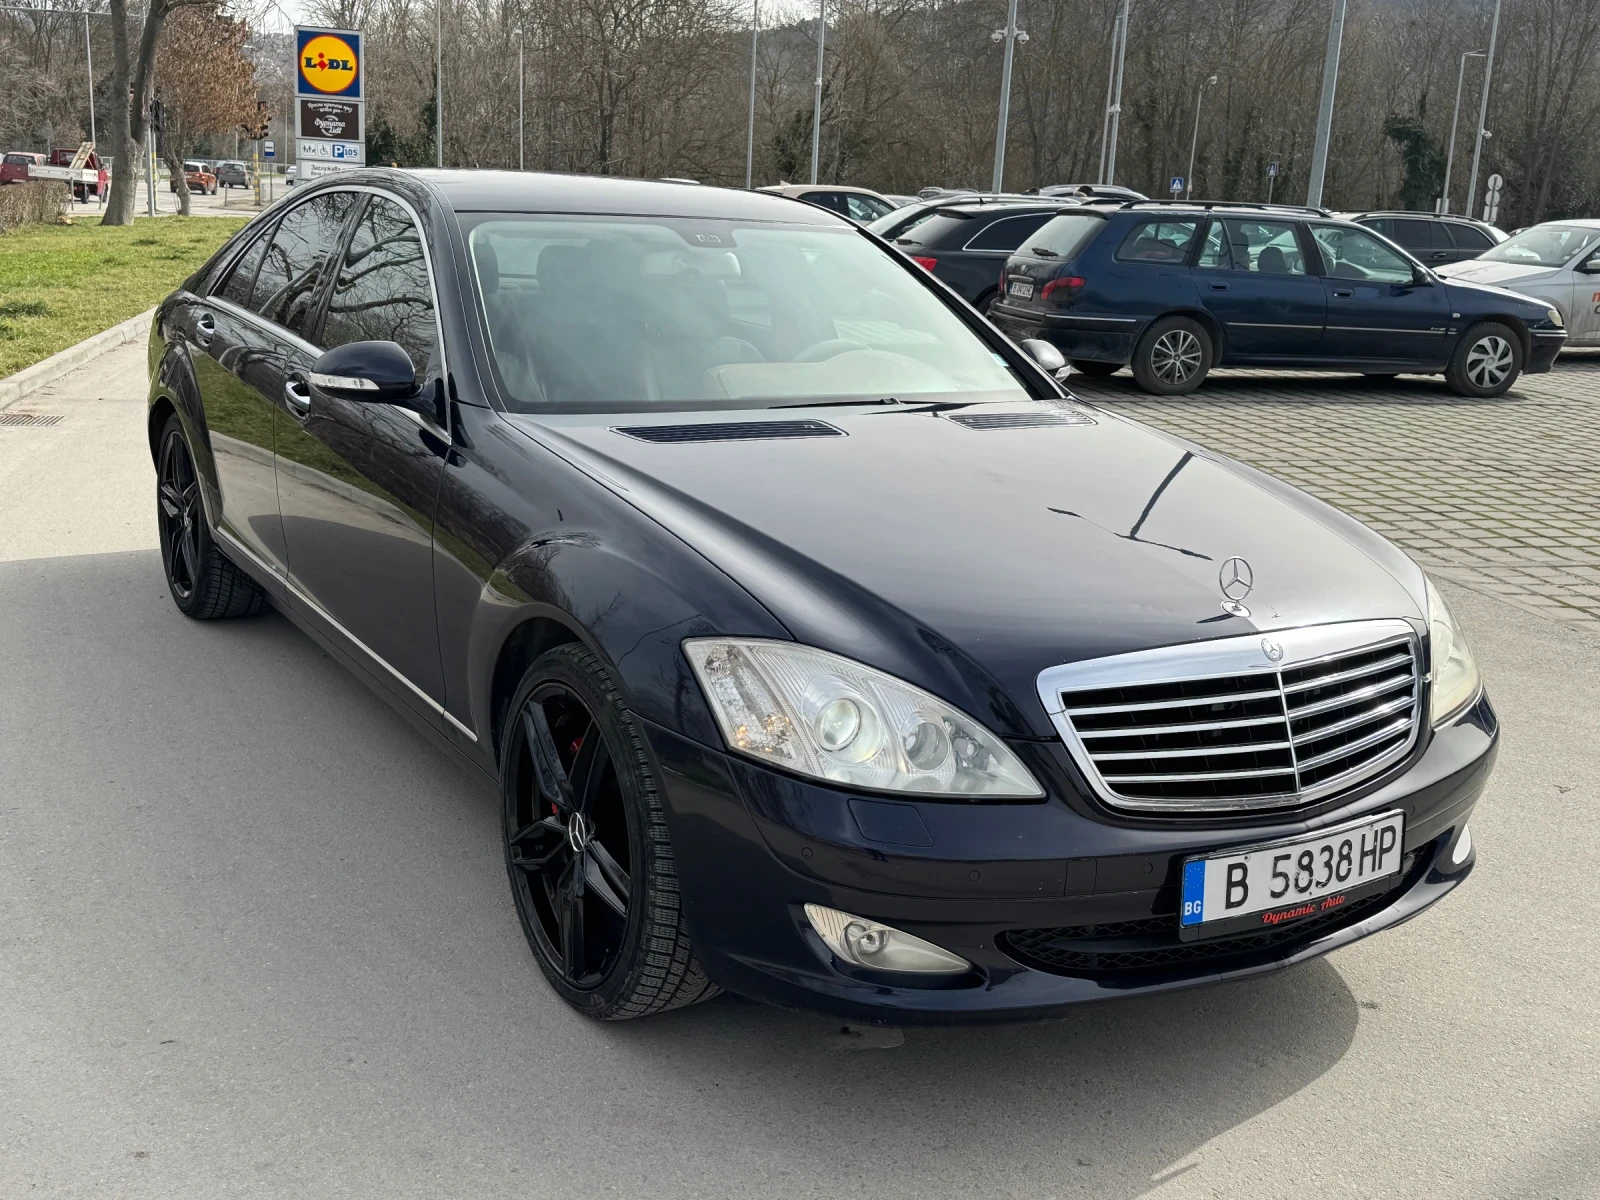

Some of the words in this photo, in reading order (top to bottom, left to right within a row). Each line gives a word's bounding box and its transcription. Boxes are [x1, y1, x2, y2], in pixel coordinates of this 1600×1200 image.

[304, 52, 353, 72] LIDL
[334, 145, 343, 157] P
[344, 148, 358, 156] 105
[1225, 862, 1249, 910] B
[1184, 901, 1202, 916] BG
[1261, 902, 1316, 925] Dynamic
[1320, 895, 1346, 910] Auto
